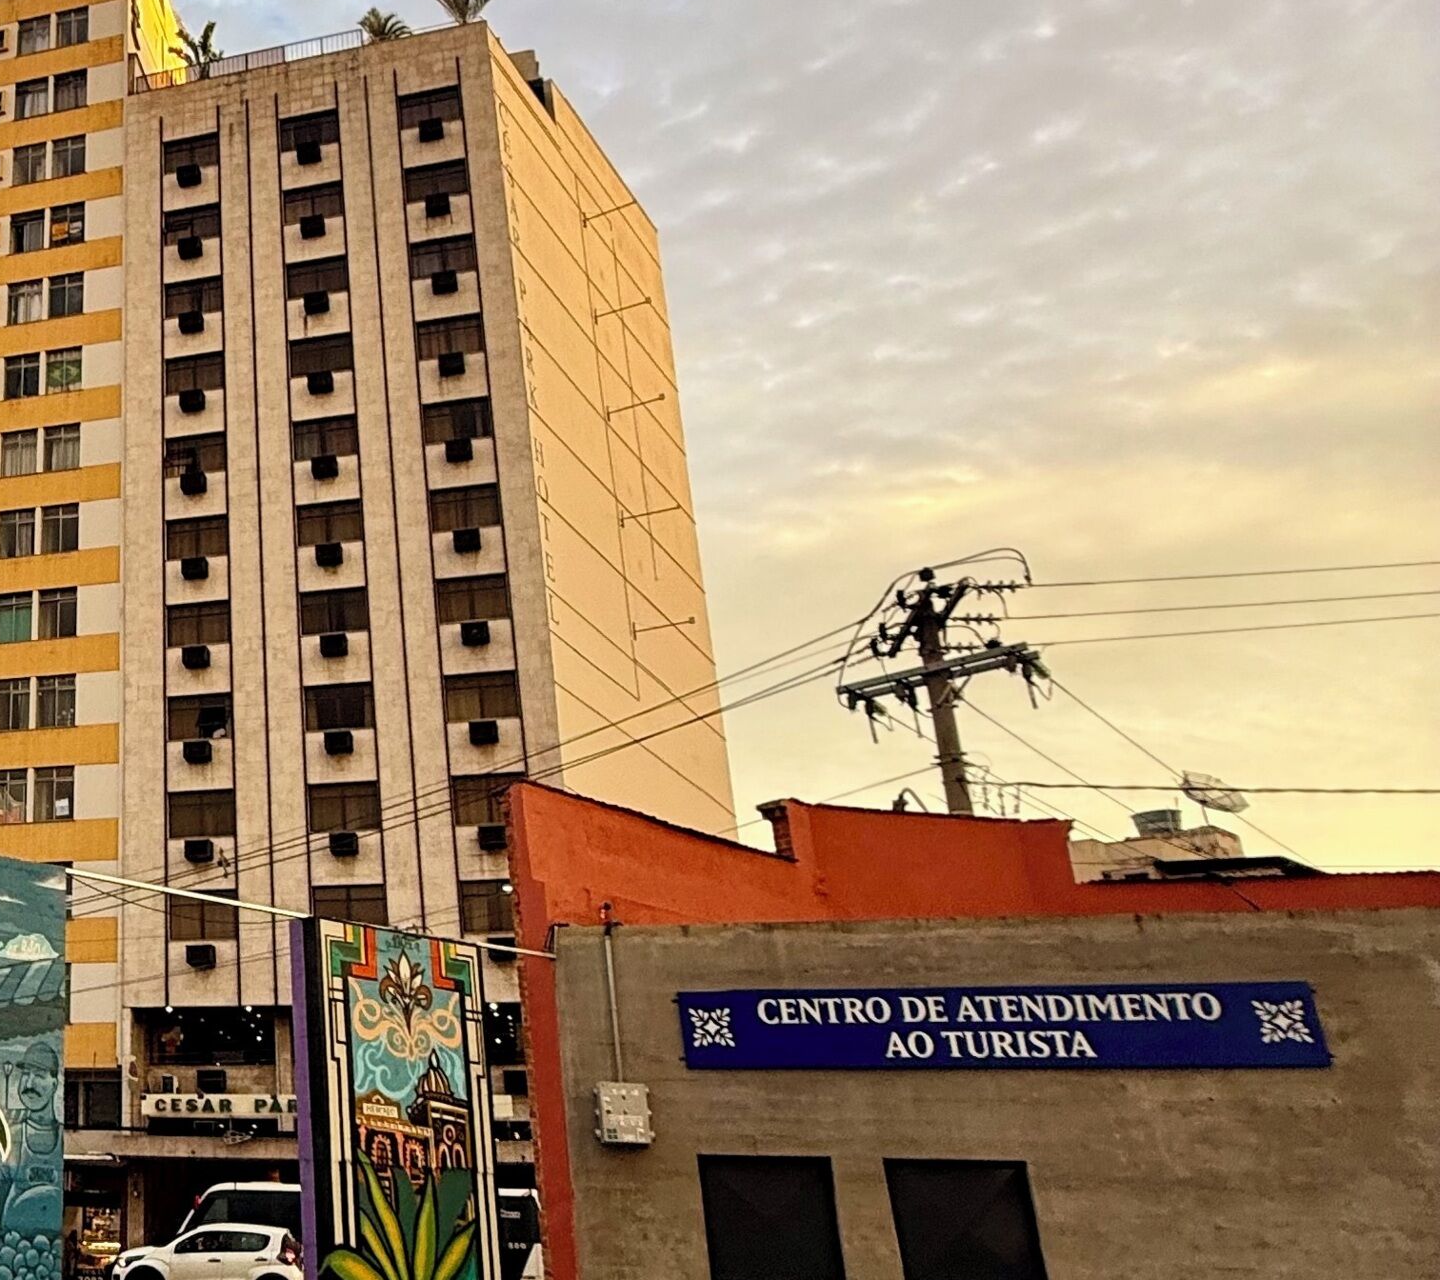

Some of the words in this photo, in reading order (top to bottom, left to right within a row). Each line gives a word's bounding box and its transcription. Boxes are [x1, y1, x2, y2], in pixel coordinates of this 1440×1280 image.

[498, 101, 521, 249] CESAR
[533, 436, 560, 626] HOTEL
[756, 996, 893, 1026] CENTRO
[901, 996, 950, 1024] DE
[955, 992, 1223, 1024] ATENDIMENTO
[885, 1030, 932, 1060] AO
[943, 1029, 1098, 1060] TURISTA
[154, 1098, 233, 1114] CESAR
